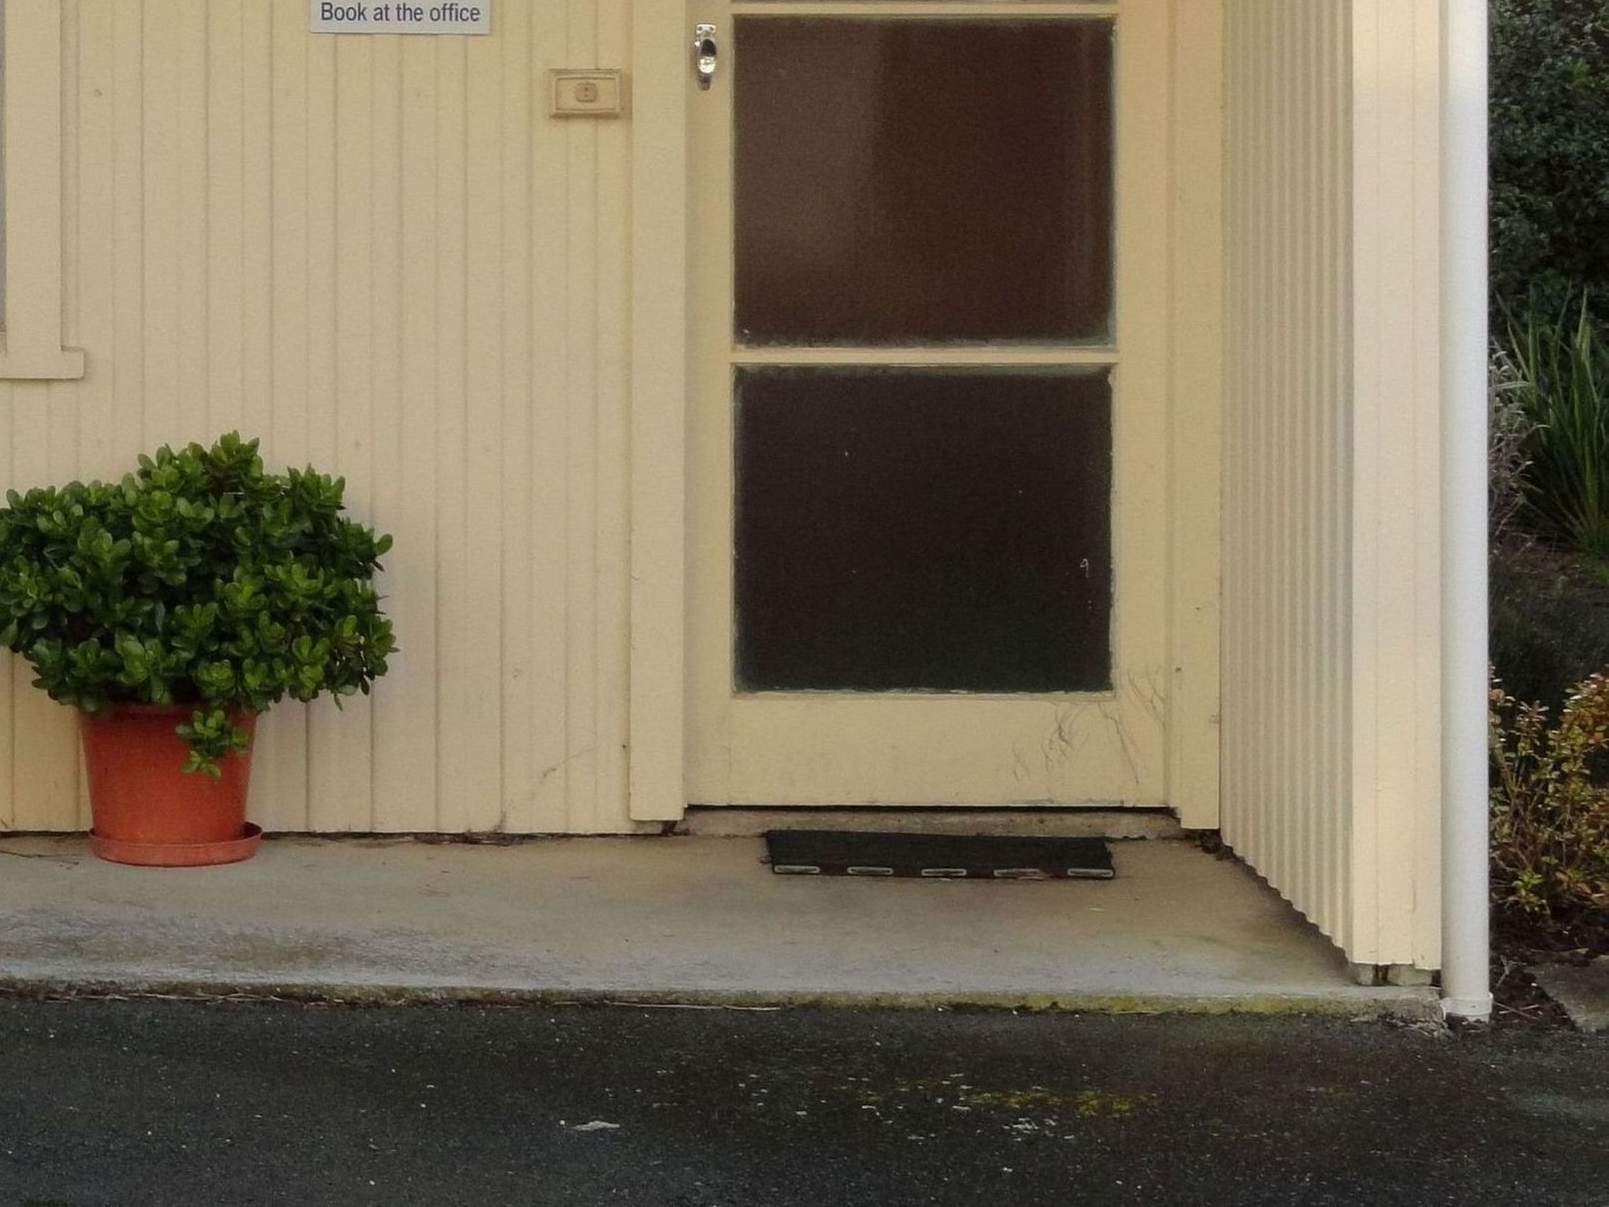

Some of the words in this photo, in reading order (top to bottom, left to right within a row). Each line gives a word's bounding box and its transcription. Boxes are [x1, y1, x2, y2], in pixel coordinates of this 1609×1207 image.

[321, 2, 367, 22] Book
[373, 3, 390, 22] at
[395, 2, 424, 21] the
[429, 2, 481, 22] office
